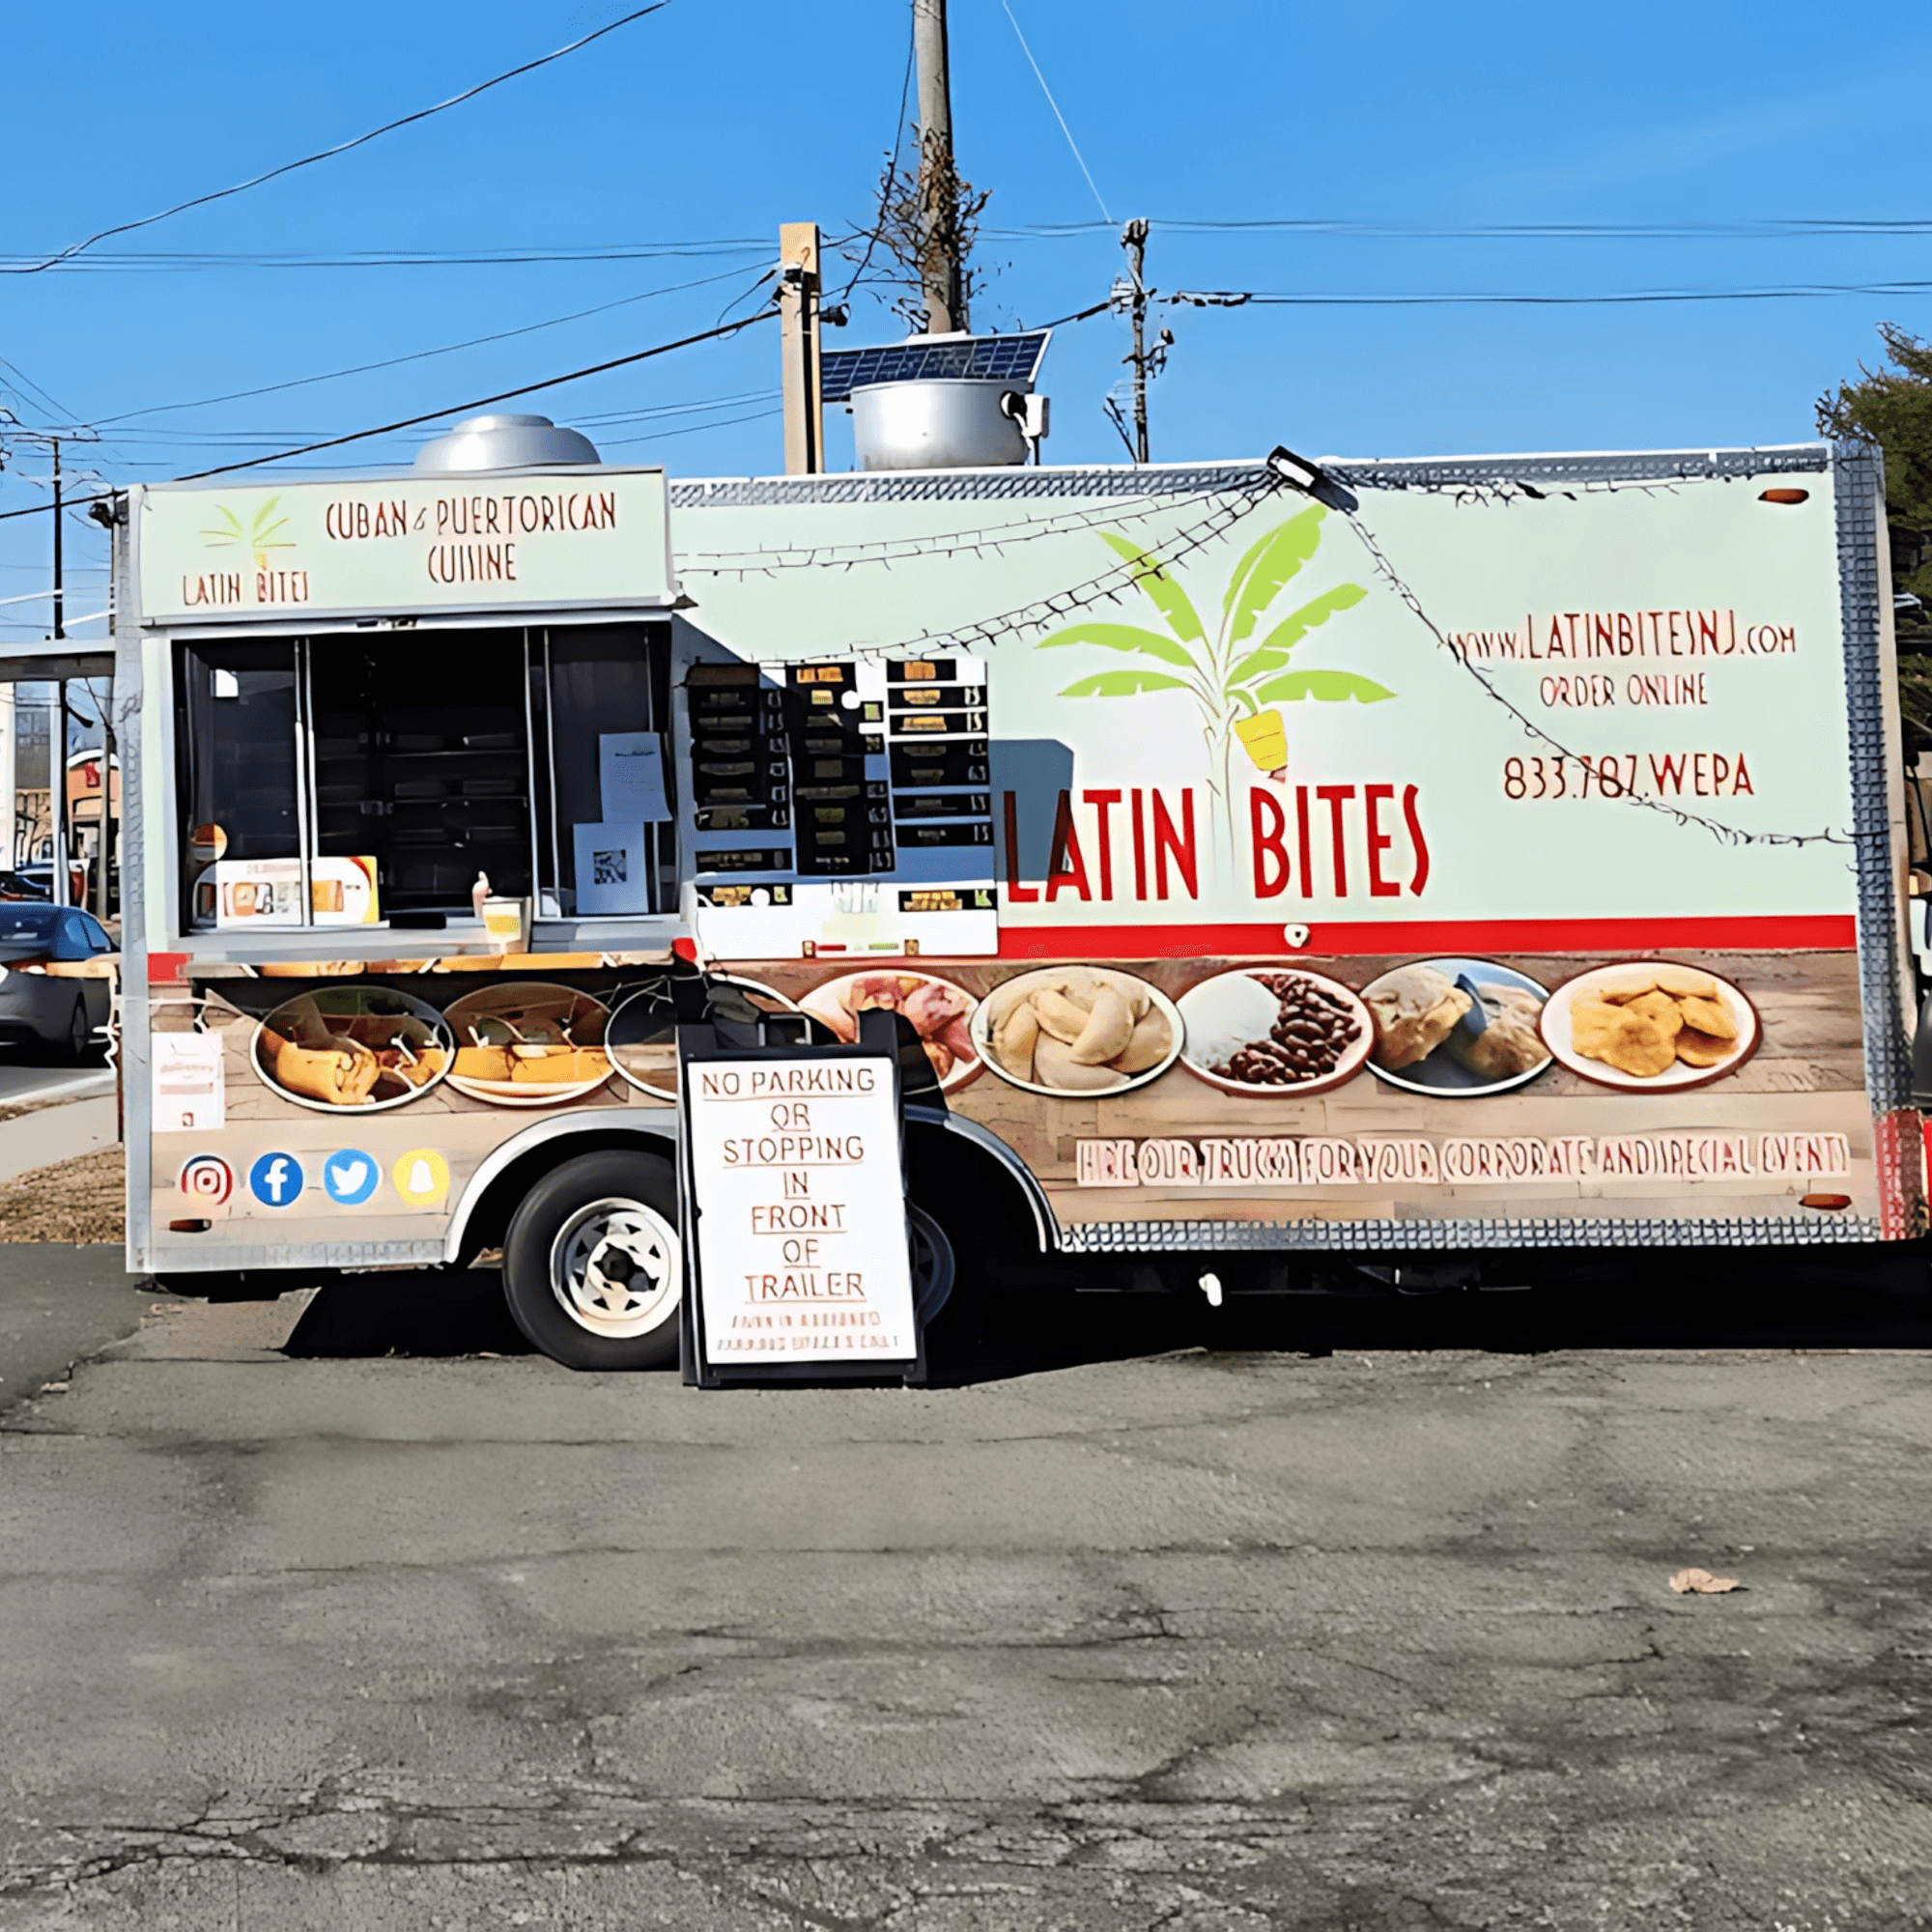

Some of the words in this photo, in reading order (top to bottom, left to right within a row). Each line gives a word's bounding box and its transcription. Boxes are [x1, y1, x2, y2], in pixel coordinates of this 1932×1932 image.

[327, 499, 408, 539] CUBAN
[438, 492, 616, 536] PUERTORICAN
[1541, 674, 1615, 707] ORDER
[1628, 672, 1709, 706] ONLINE
[1003, 787, 1199, 902] LATIN
[1250, 783, 1430, 899] BITES
[702, 1071, 741, 1095] NO
[752, 1068, 876, 1093] PARKING
[770, 1102, 811, 1130] OR
[724, 1135, 865, 1164] STOPPING
[1304, 1142, 1351, 1179] FOR
[1602, 1140, 1652, 1176] AND
[783, 1171, 809, 1196] IN
[752, 1204, 847, 1230] FRONT
[782, 1238, 819, 1264] OF
[744, 1272, 866, 1301] TRAILER
